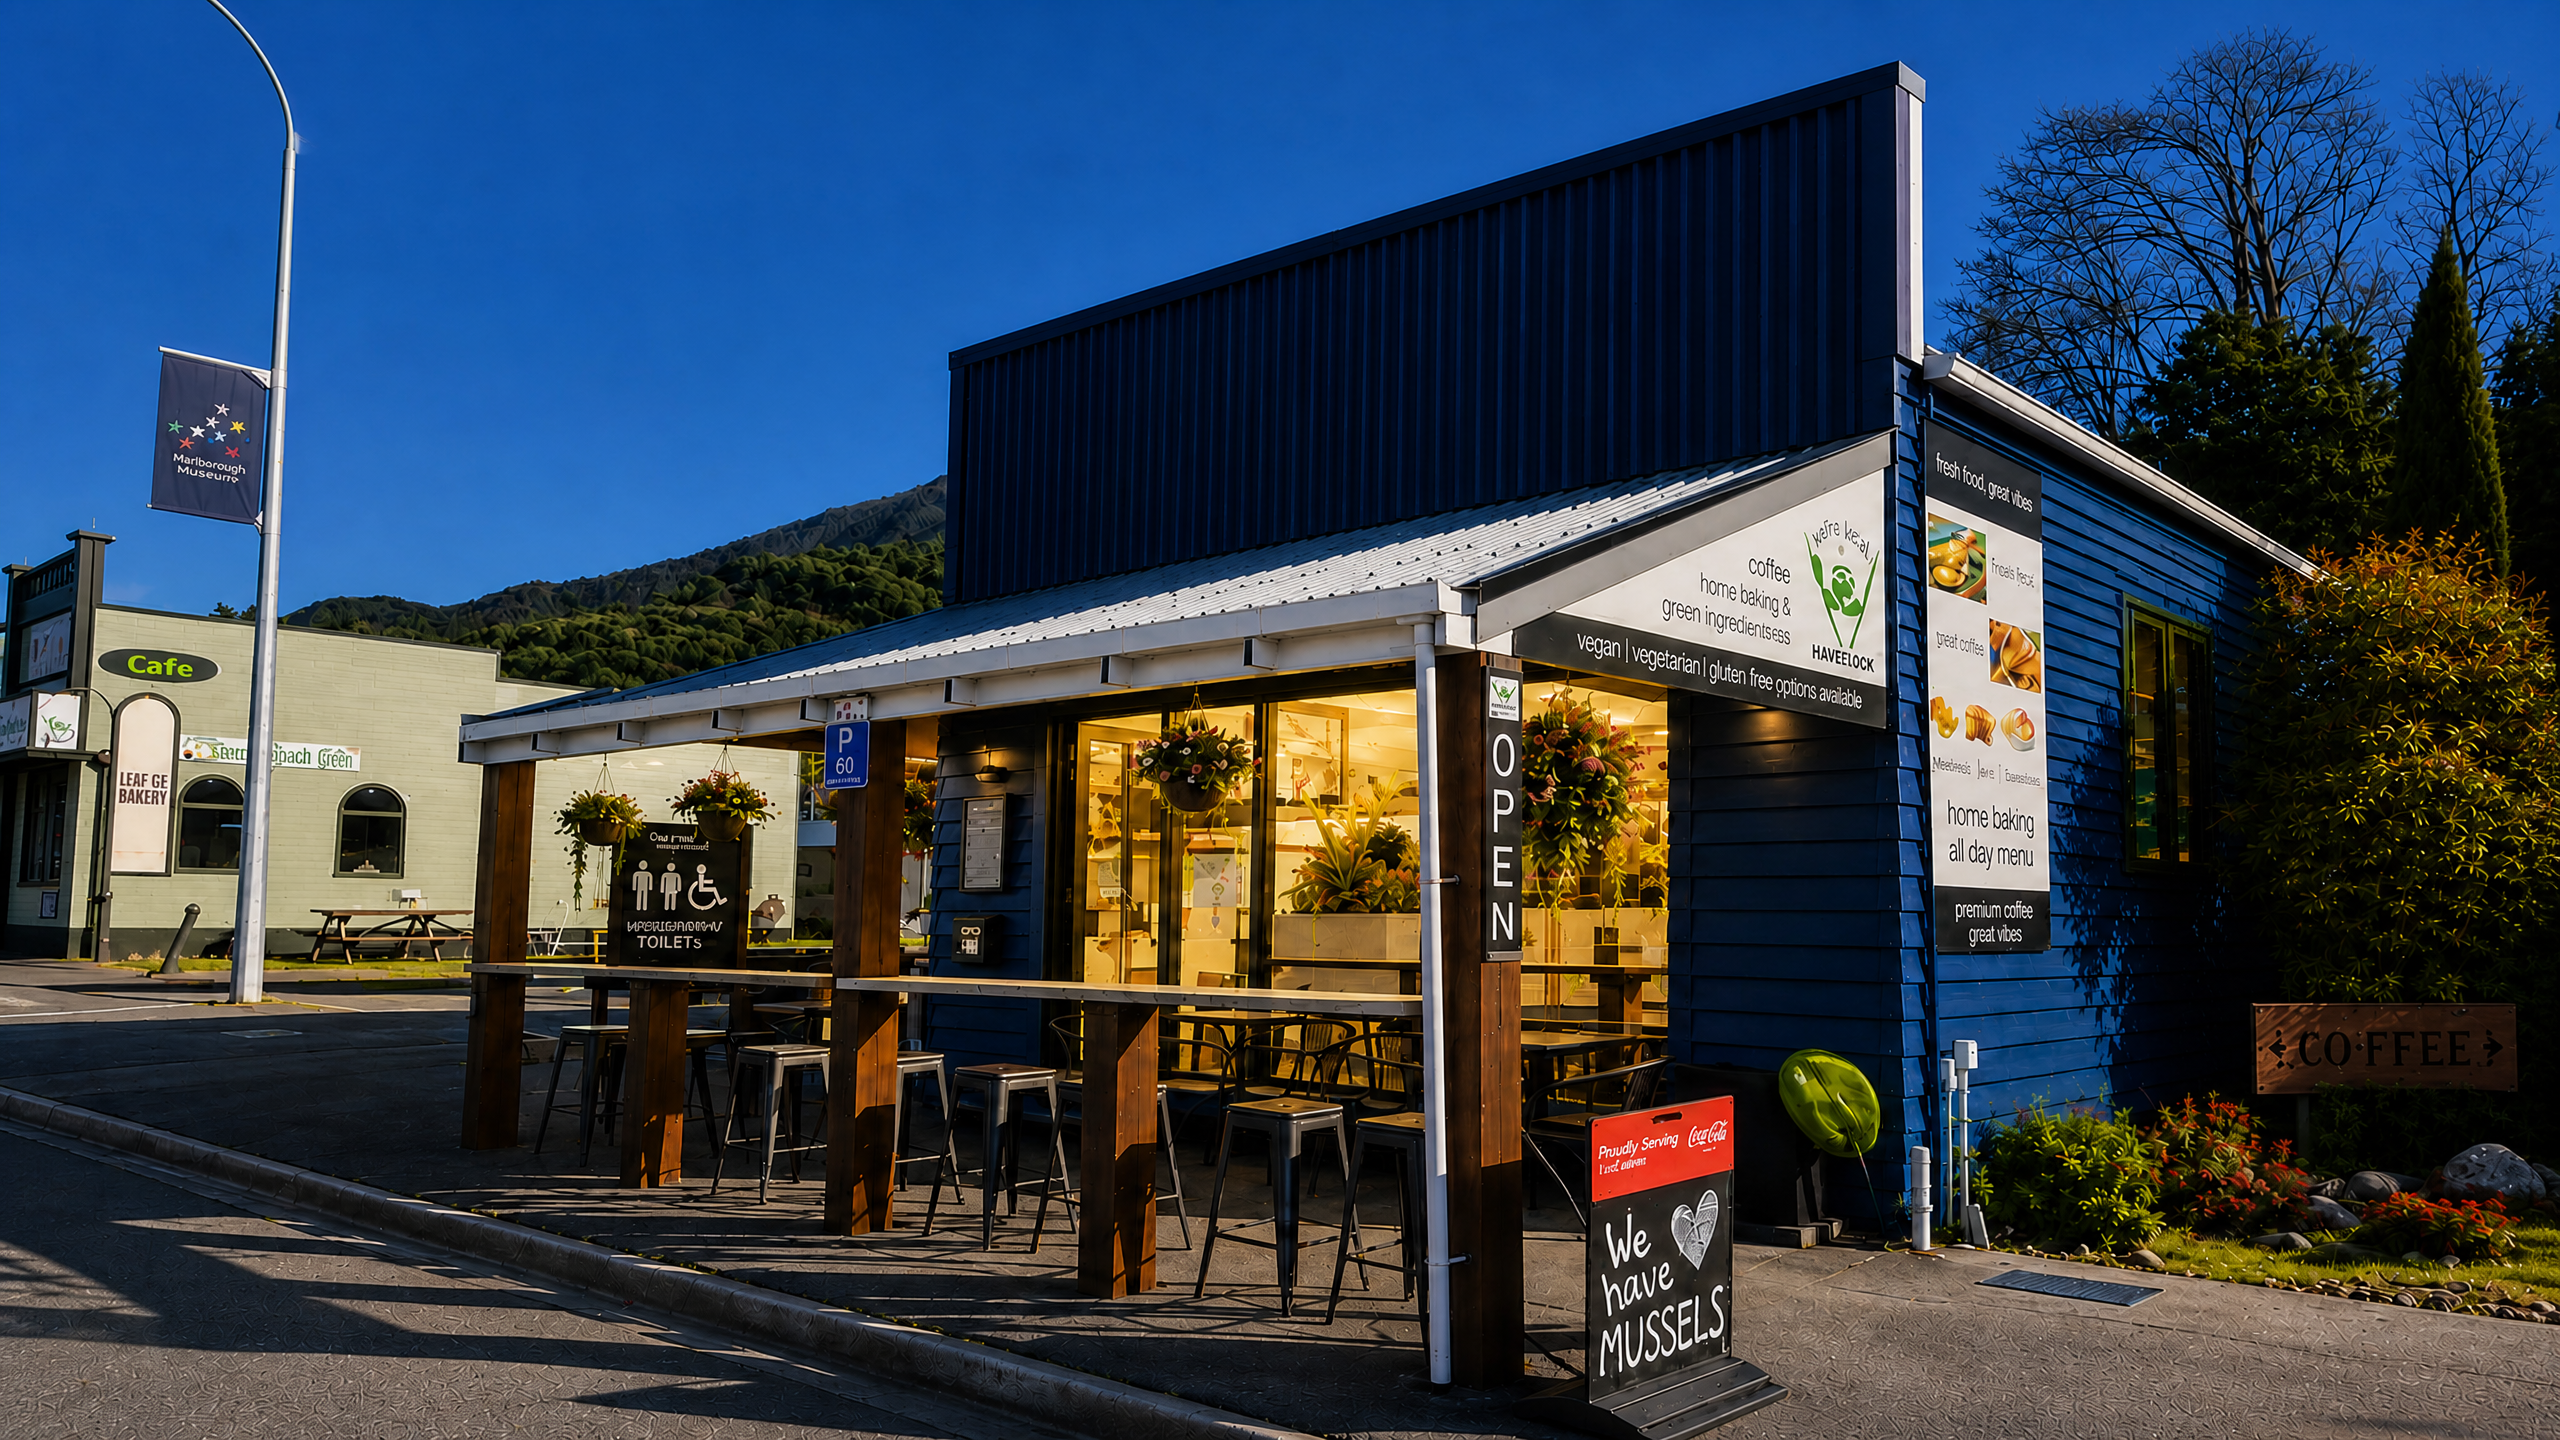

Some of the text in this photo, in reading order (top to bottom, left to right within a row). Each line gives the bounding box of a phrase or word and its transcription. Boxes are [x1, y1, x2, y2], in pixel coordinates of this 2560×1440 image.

[173, 453, 246, 475] Marlborough
[1936, 452, 2033, 513] fresh food, great vibes
[1749, 557, 1791, 584] coffee
[1700, 572, 1791, 618] home baking &
[1662, 599, 1701, 622] green
[127, 655, 194, 677] Cafe
[1577, 633, 1621, 660] vegan
[1632, 646, 1701, 675] vegetarian
[1709, 659, 1746, 685] gluten
[1749, 667, 1773, 691] free
[1819, 686, 1863, 709] available
[838, 727, 853, 753] P
[835, 756, 854, 775] 60
[119, 772, 169, 789] LEAF GE
[118, 788, 168, 805] BAKERY
[1947, 799, 2034, 839] home baking
[1492, 733, 1516, 941] OPEN
[1949, 837, 2034, 871] all day menu
[1955, 899, 2034, 923] premium coffee
[1968, 923, 2023, 948] great vibes
[1641, 1132, 1679, 1151] Serving
[1605, 1213, 1651, 1269] We
[1601, 1261, 1674, 1317] have
[1599, 1284, 1725, 1377] MUSSELS
